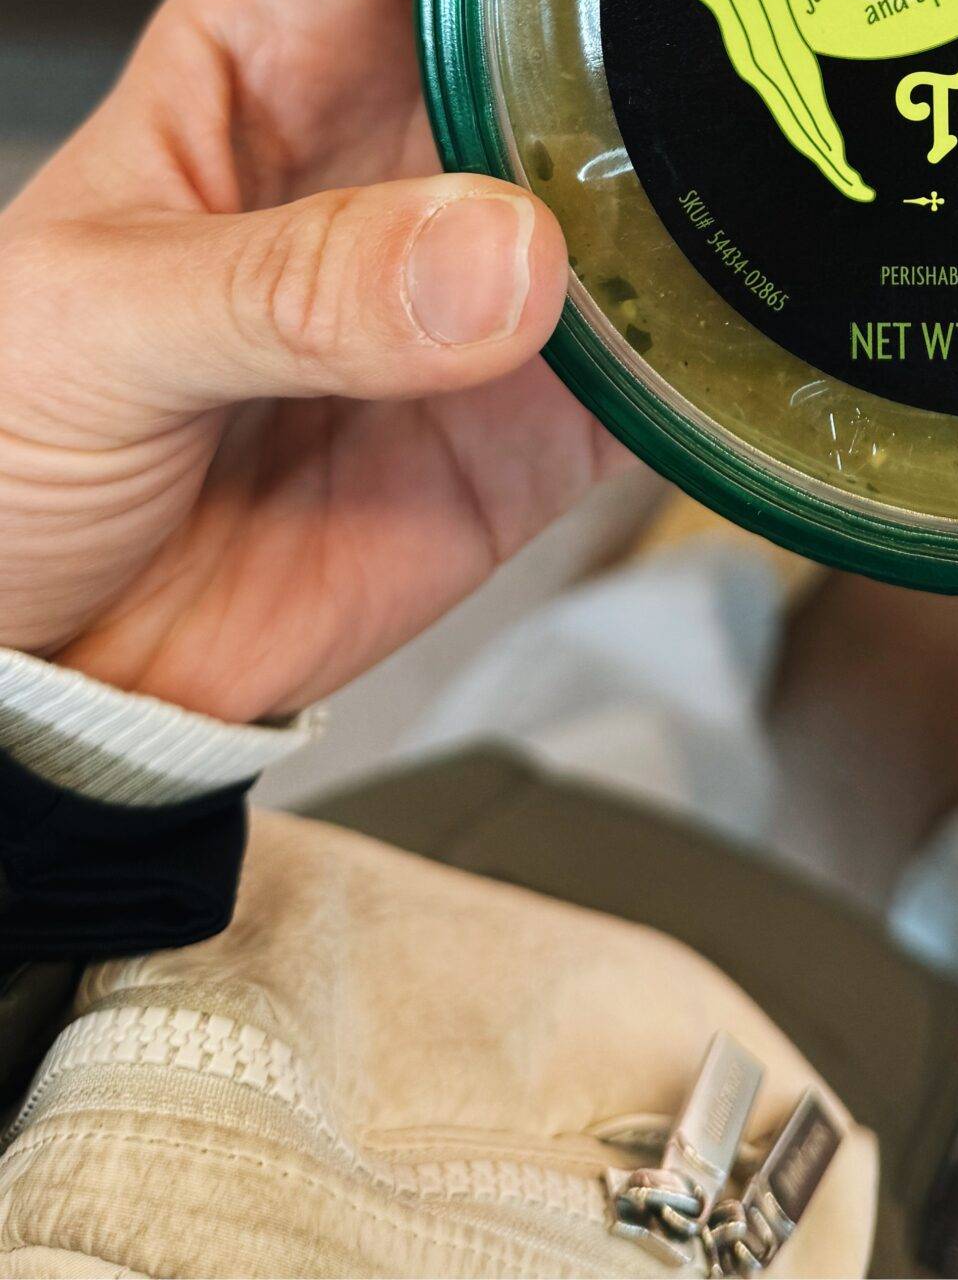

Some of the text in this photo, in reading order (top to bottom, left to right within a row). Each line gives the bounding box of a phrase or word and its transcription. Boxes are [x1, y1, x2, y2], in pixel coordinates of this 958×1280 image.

[679, 190, 789, 311] SKU# 54434-02865
[851, 322, 911, 360] NET
